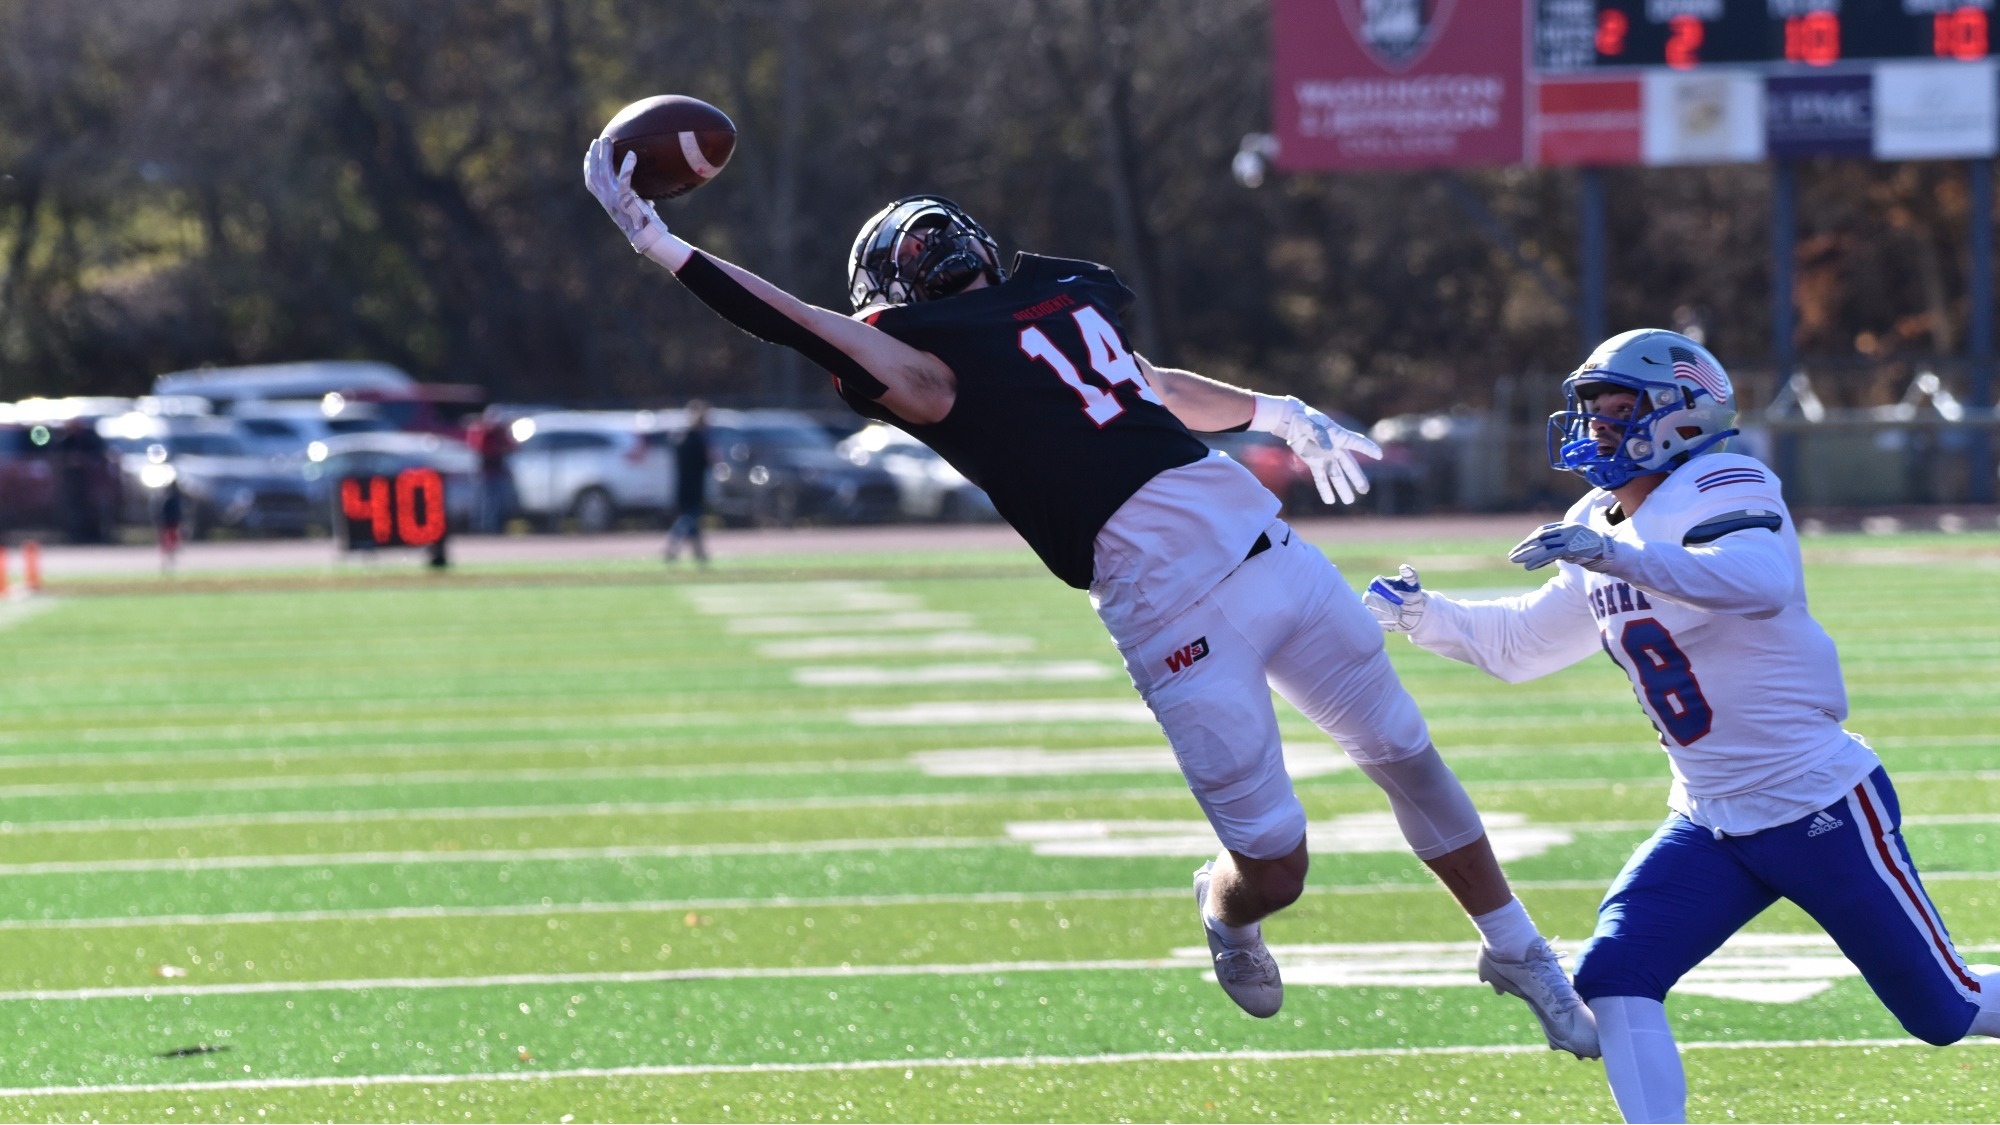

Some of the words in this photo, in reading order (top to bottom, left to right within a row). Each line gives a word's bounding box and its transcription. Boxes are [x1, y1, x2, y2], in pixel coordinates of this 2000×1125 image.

[1664, 14, 1704, 70] 2
[1784, 11, 1840, 66] 10
[1933, 6, 1988, 61] 10
[1012, 293, 1075, 321] PRESIDENTS
[1018, 304, 1166, 429] 14
[341, 468, 446, 546] 40
[1164, 635, 1210, 674] W&J
[1807, 819, 1844, 838] adidas
